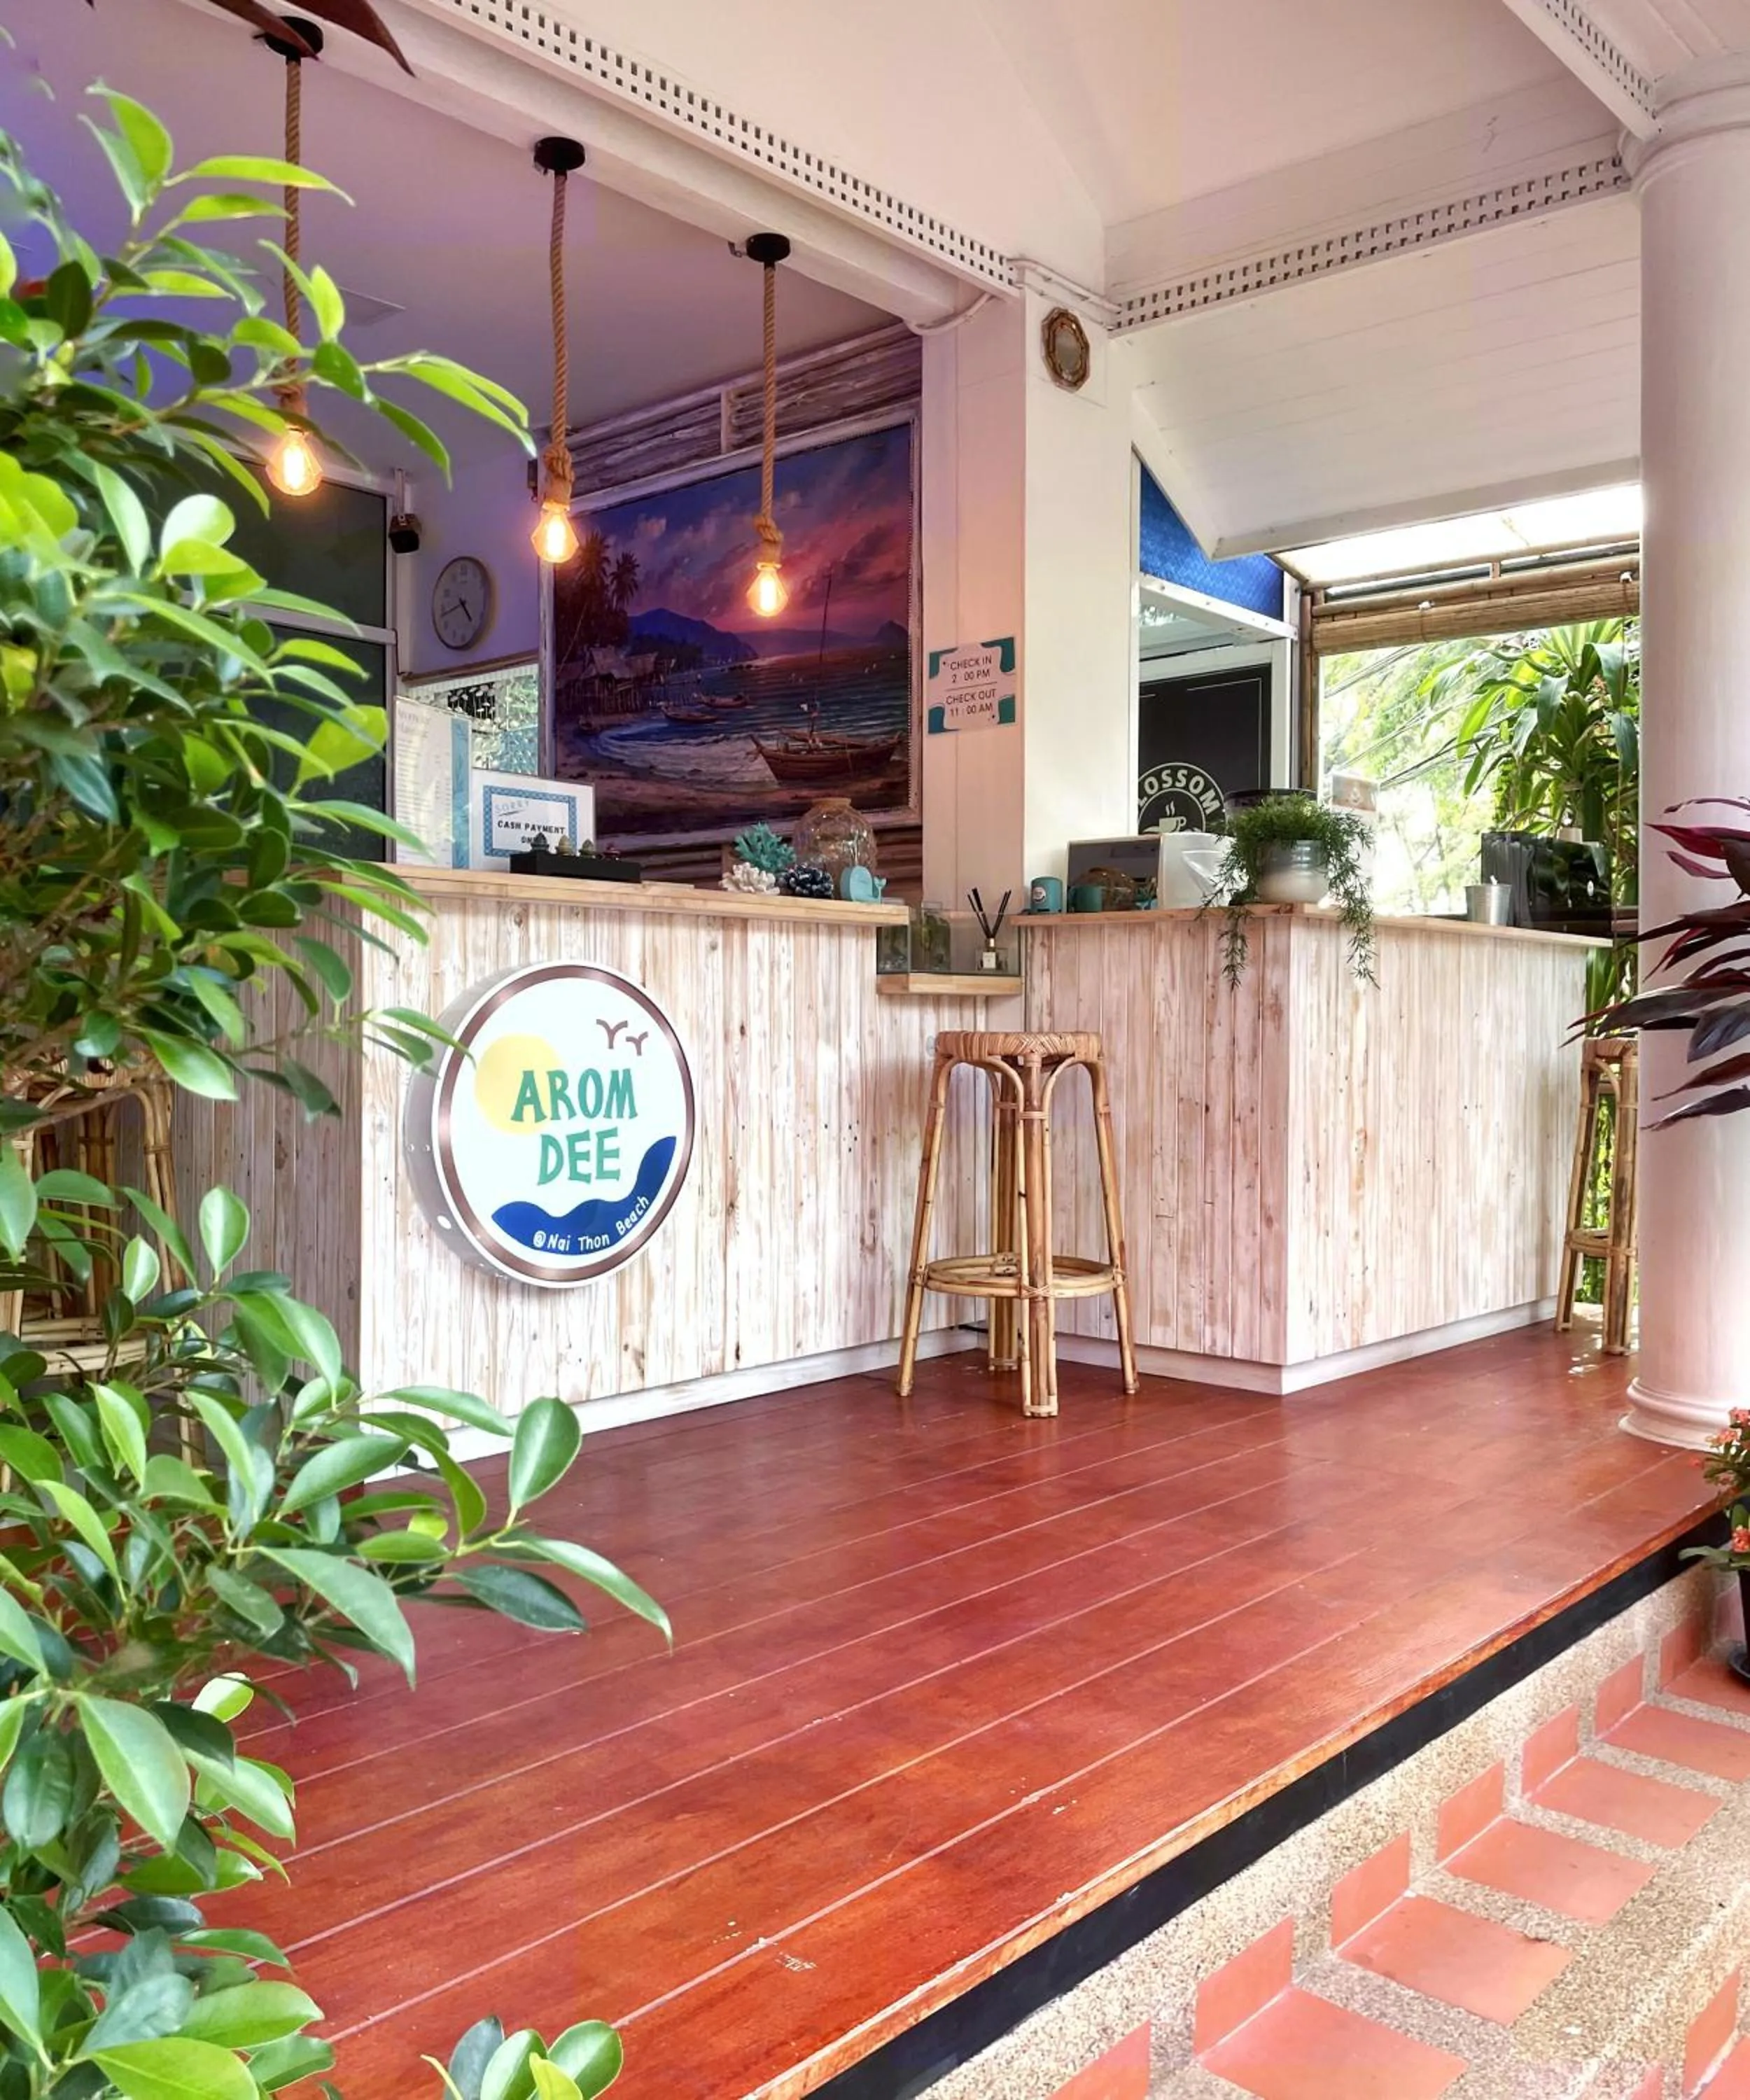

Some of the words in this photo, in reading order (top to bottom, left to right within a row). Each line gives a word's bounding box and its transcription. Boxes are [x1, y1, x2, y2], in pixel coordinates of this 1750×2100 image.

[950, 658, 980, 671] CHECK
[982, 655, 992, 665] IN
[977, 668, 990, 679] PM
[946, 692, 976, 705] CHECK
[979, 689, 996, 700] OUT
[979, 703, 993, 713] AM
[498, 820, 522, 830] CASH
[525, 822, 566, 835] PAYMENT
[510, 1068, 638, 1123] AROM
[538, 1126, 620, 1185] DEE
[533, 1230, 570, 1251] @Nai
[578, 1234, 610, 1251] Thon
[615, 1196, 650, 1236] Beach
